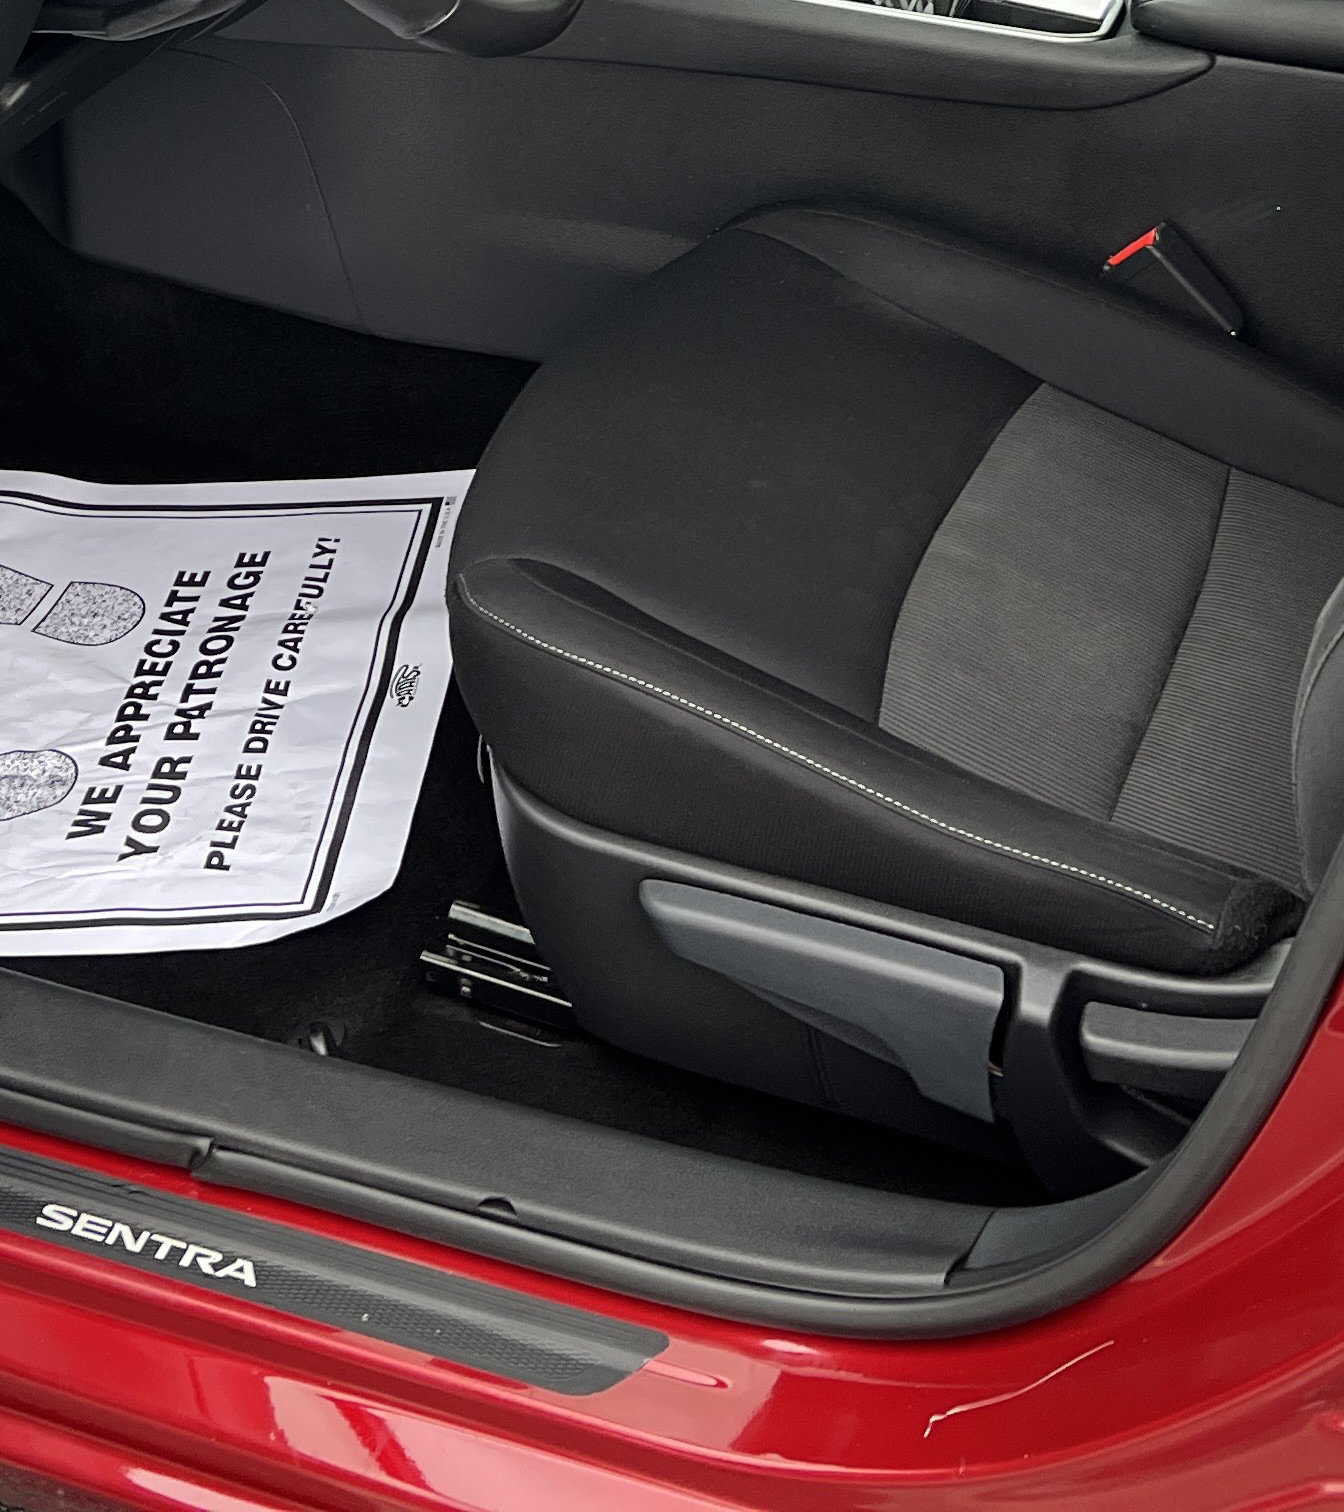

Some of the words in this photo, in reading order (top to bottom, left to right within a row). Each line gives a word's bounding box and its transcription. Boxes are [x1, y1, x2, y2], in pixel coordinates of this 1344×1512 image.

[65, 784, 124, 840] WE
[97, 570, 212, 772] APPRECIATE
[117, 755, 195, 863] YOUR
[163, 550, 272, 741] PATRONAGE
[203, 763, 263, 871] PLEASE
[242, 678, 291, 754] DRIVE
[271, 537, 342, 672] CAREFULLY!
[35, 1203, 257, 1288] SENTRA
